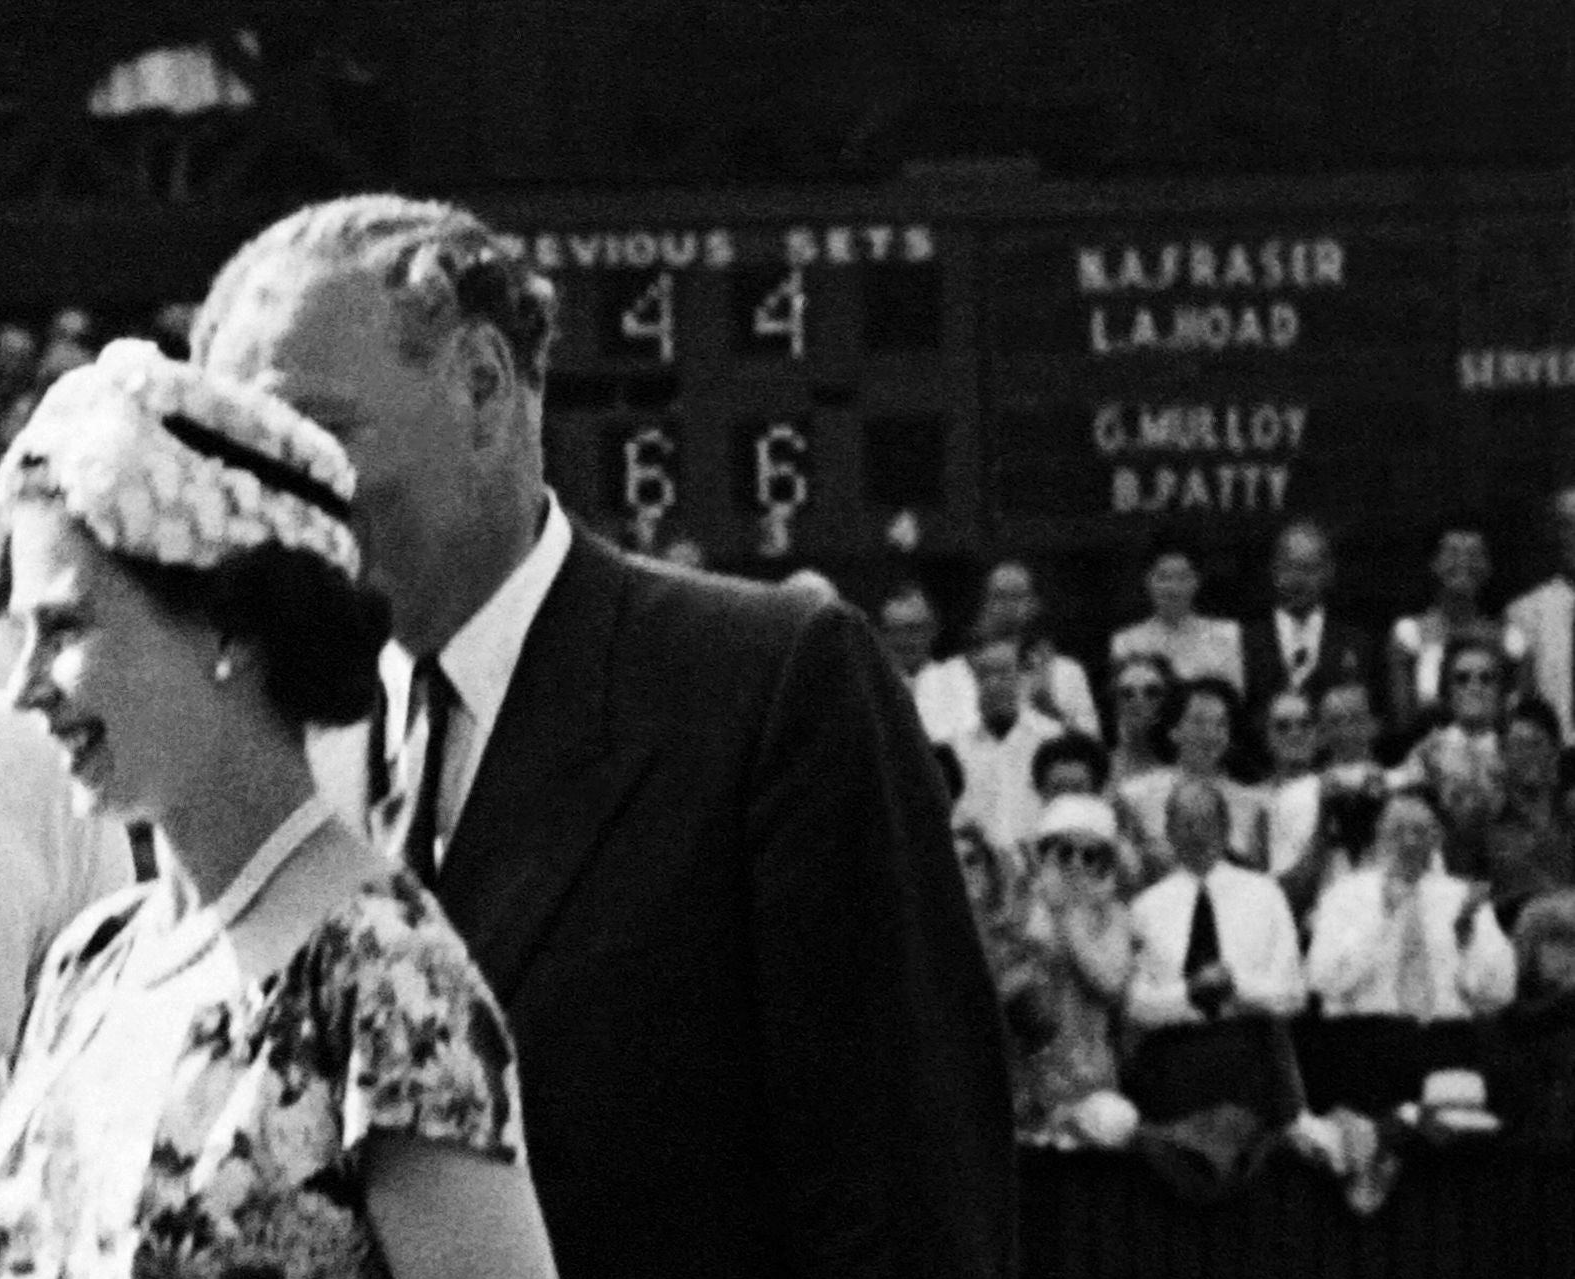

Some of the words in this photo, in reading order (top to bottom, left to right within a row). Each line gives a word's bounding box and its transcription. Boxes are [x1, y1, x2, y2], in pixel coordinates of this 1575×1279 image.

[784, 225, 934, 265] SETS
[621, 270, 674, 364] 4
[754, 266, 805, 360] 4
[624, 427, 675, 507] 6
[756, 423, 807, 507] 6
